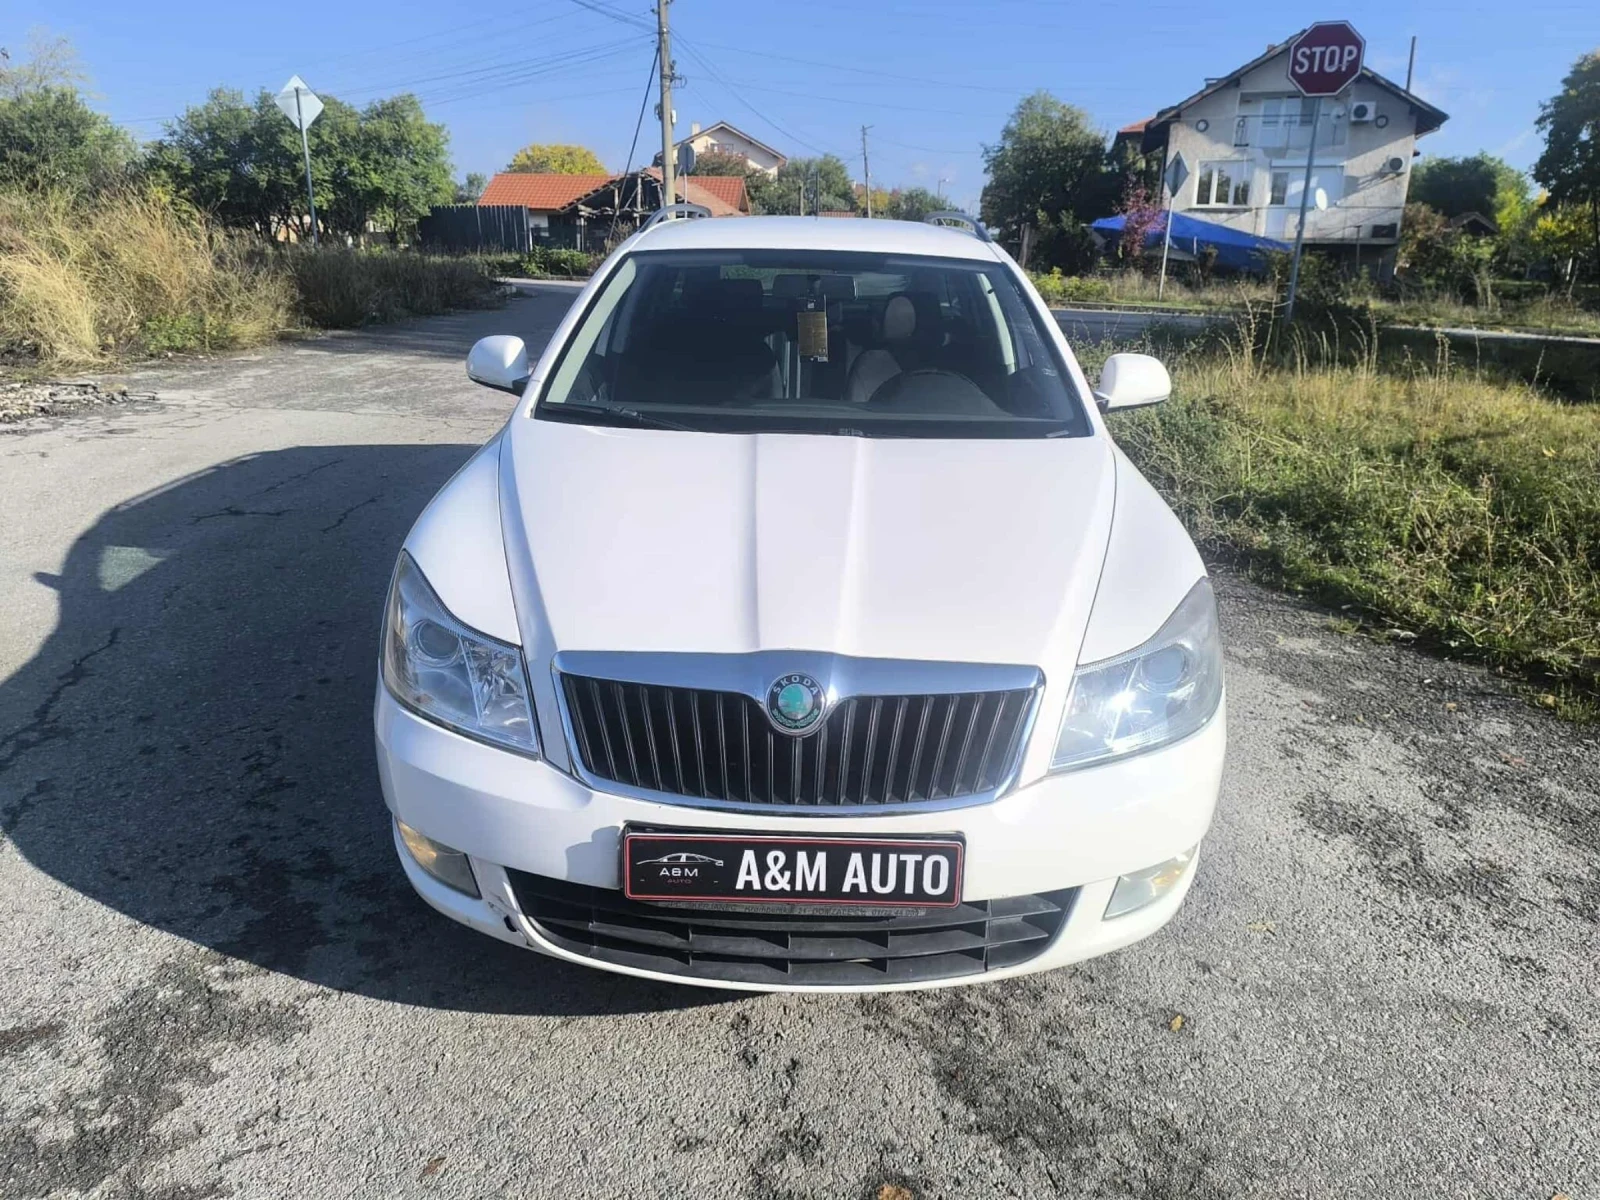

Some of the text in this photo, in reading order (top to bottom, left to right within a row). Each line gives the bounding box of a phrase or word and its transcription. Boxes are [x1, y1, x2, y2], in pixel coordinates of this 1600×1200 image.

[1294, 45, 1358, 74] STOP
[735, 849, 950, 896] A&M AUTO
